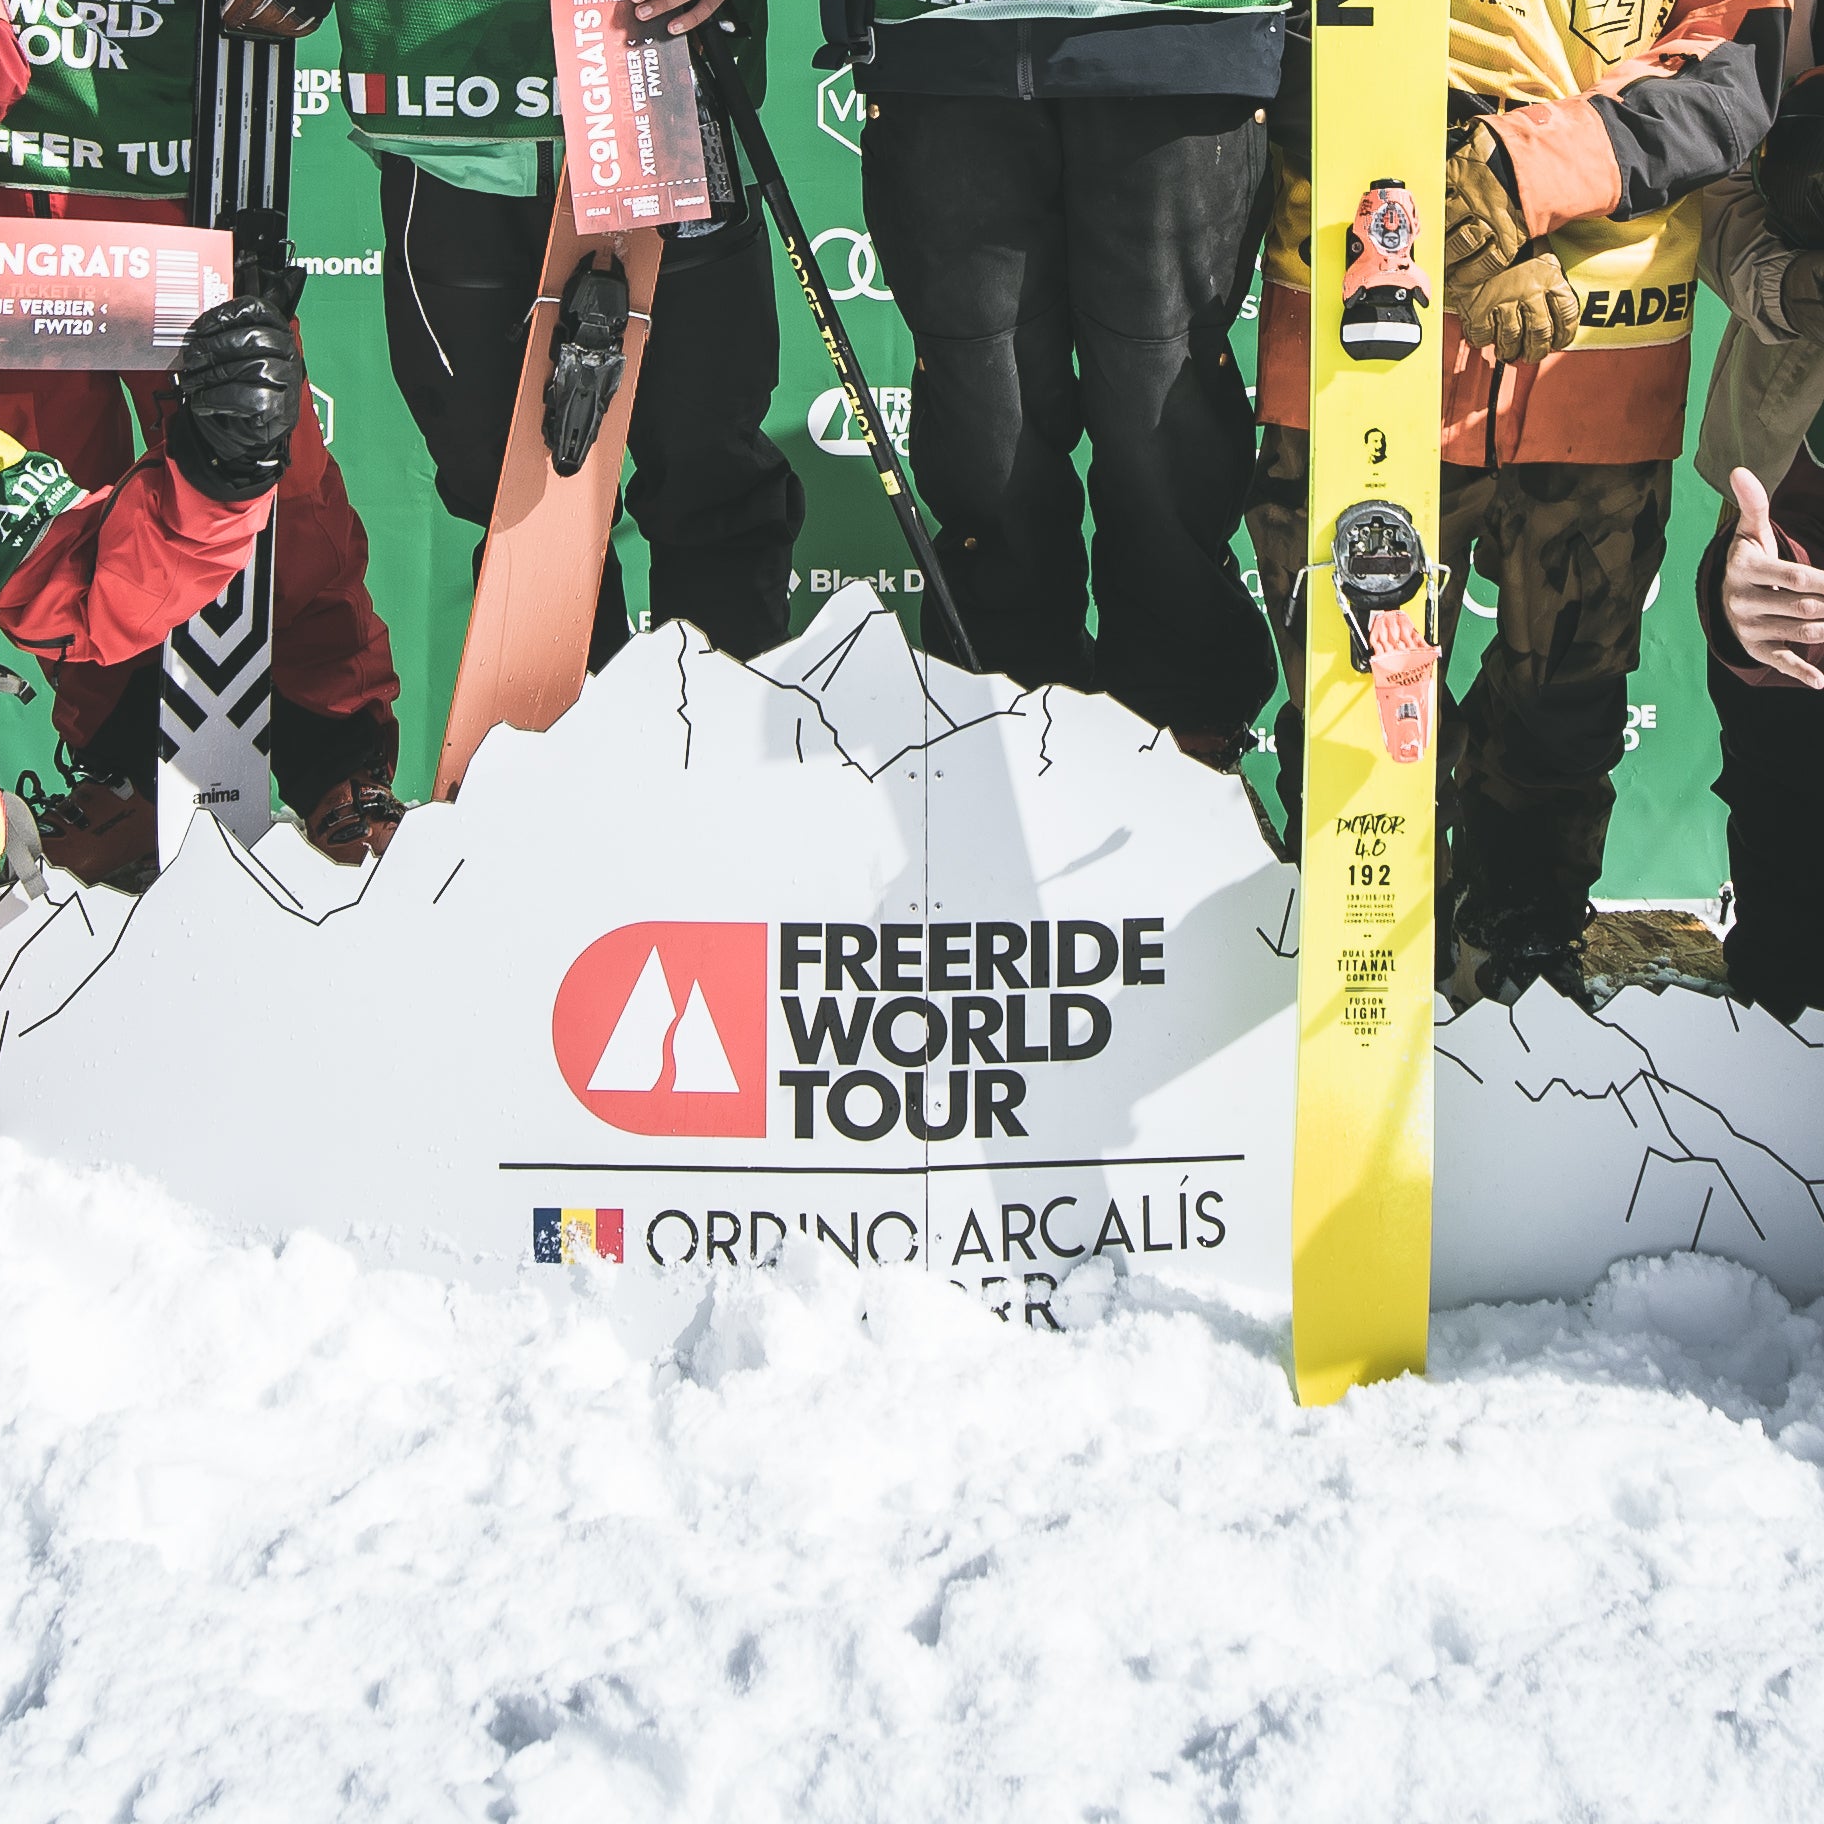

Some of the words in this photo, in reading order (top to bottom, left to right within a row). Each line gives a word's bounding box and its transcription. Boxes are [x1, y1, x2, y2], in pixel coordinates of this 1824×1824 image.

[626, 49, 648, 113] VERBIER
[643, 48, 663, 98] FWT20
[397, 75, 500, 118] LEO
[574, 9, 622, 187] CONGRATS
[635, 114, 657, 177] XTREME
[20, 298, 95, 316] VERBIER
[34, 318, 94, 336] FWT20
[1349, 865, 1391, 886] 192
[779, 917, 1166, 991] FREERIDE
[1337, 960, 1396, 972] TITANAL
[1342, 950, 1364, 958] DUAL
[1370, 950, 1393, 958] SPAN
[1346, 974, 1388, 982] CONTROL
[781, 992, 1114, 1067] WORLD
[1345, 1008, 1386, 1019] LIGHT
[1355, 1027, 1377, 1035] CORE
[779, 1070, 1029, 1141] TOUR
[952, 1176, 1229, 1267] ARCALÍS
